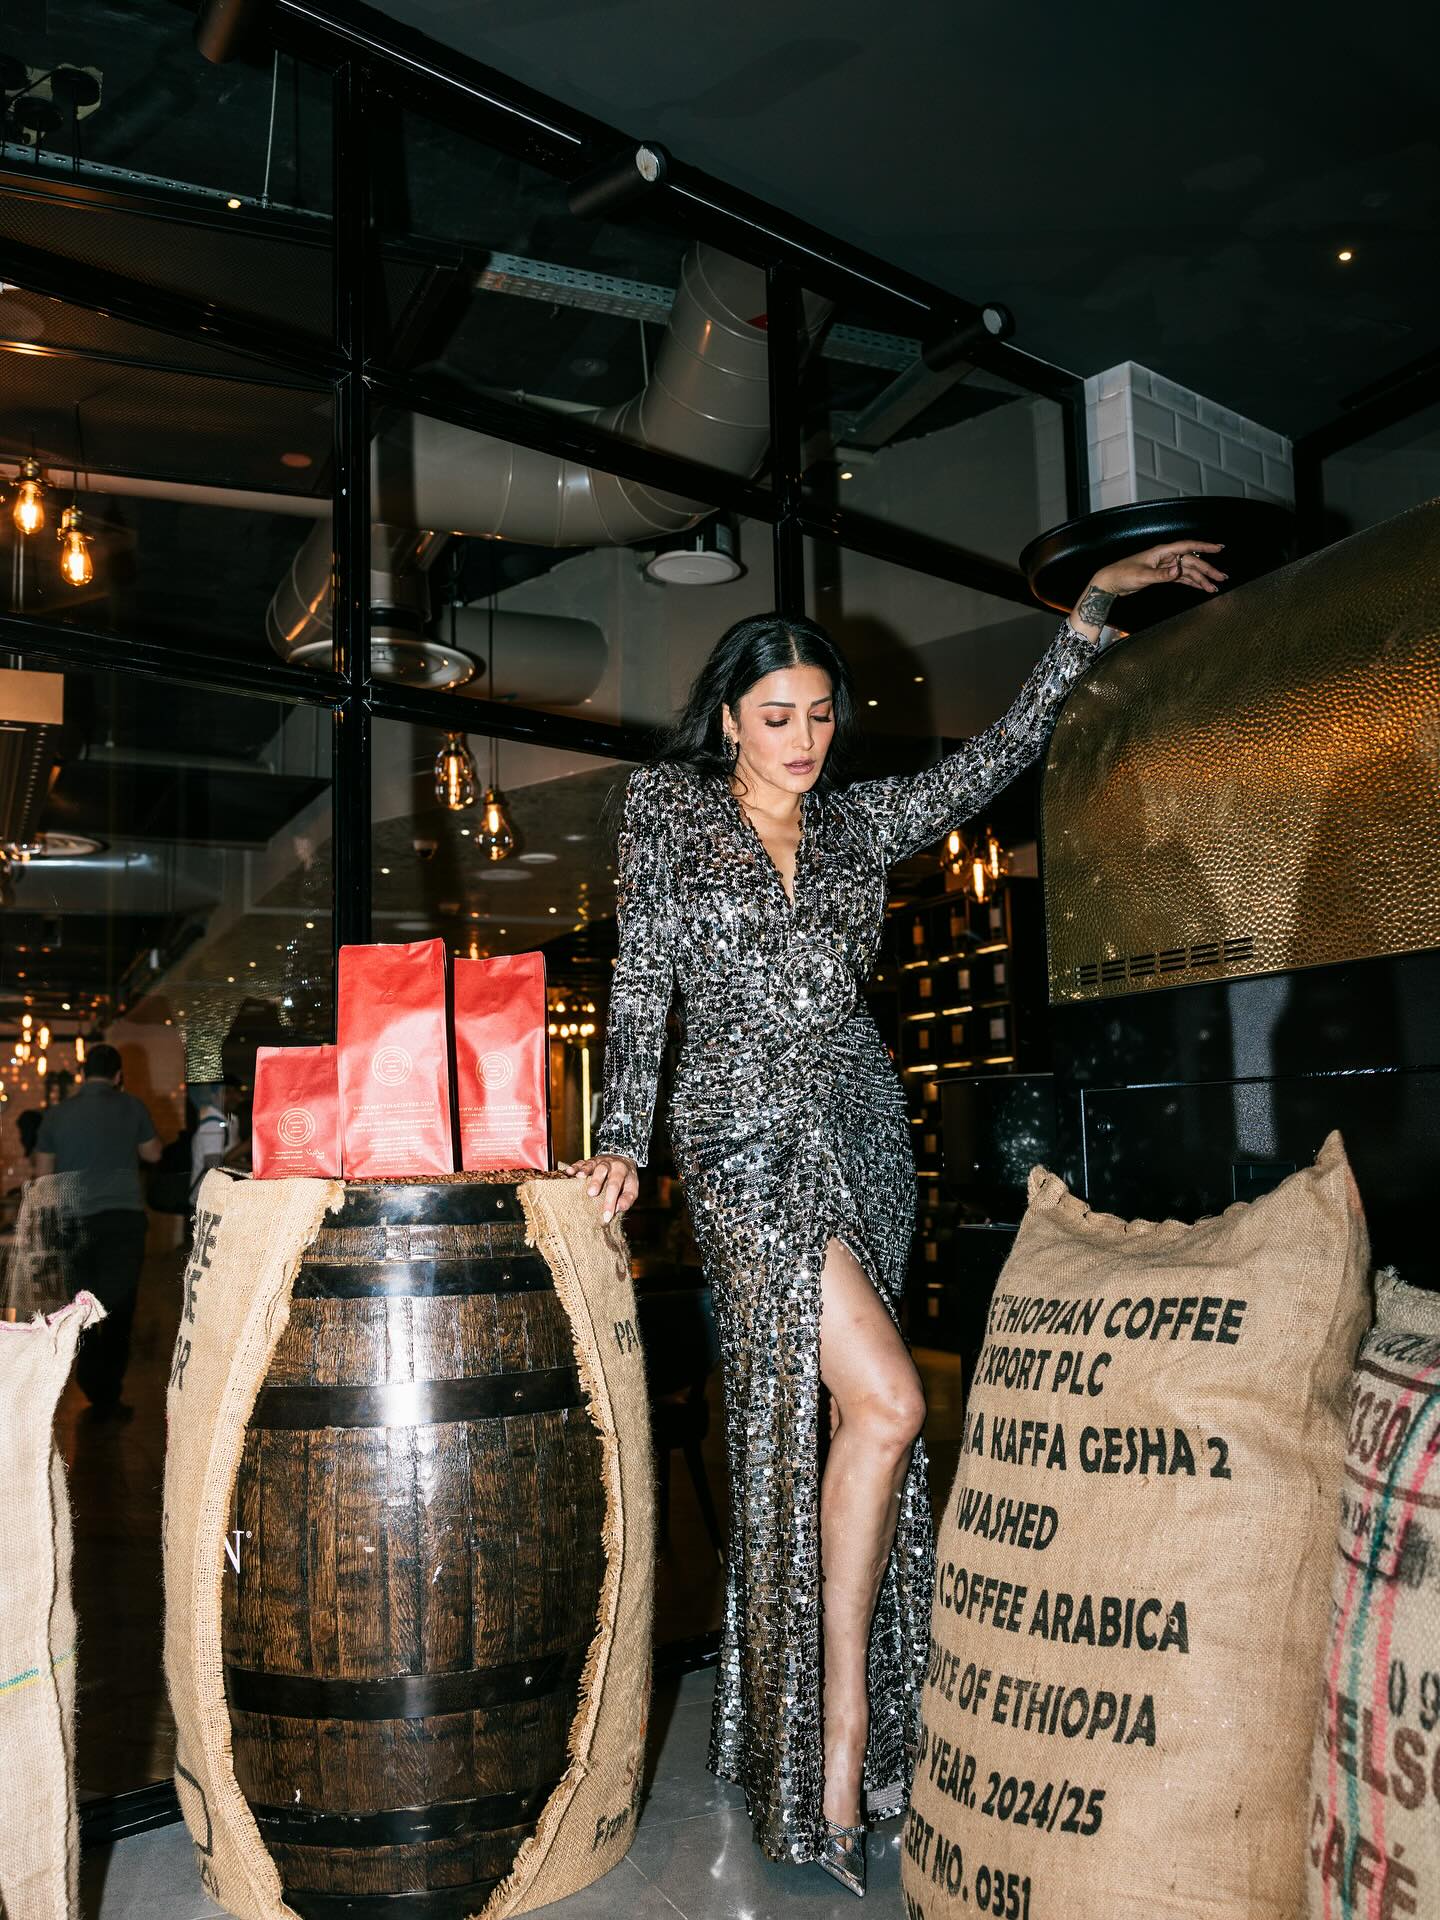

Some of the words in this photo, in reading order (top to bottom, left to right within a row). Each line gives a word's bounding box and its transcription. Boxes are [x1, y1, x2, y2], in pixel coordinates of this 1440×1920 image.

[1103, 1296, 1248, 1346] COFFEE
[1051, 1350, 1113, 1397] PLC
[990, 1415, 1067, 1471] KAFFA
[1079, 1425, 1196, 1477] GESHA
[1207, 1437, 1233, 1481] 2
[956, 1487, 1059, 1551] WASHED
[939, 1562, 1027, 1633] COFFEE
[1028, 1589, 1190, 1654] ARABICA
[958, 1662, 993, 1716] OF
[991, 1674, 1158, 1747] ETHIOPIA
[1323, 1680, 1440, 1811] ELS
[929, 1731, 977, 1810] YEAR.
[981, 1771, 1106, 1836] 2024/25
[904, 1806, 935, 1874] ERT
[932, 1834, 969, 1902] NO.
[975, 1864, 1032, 1920] 0351
